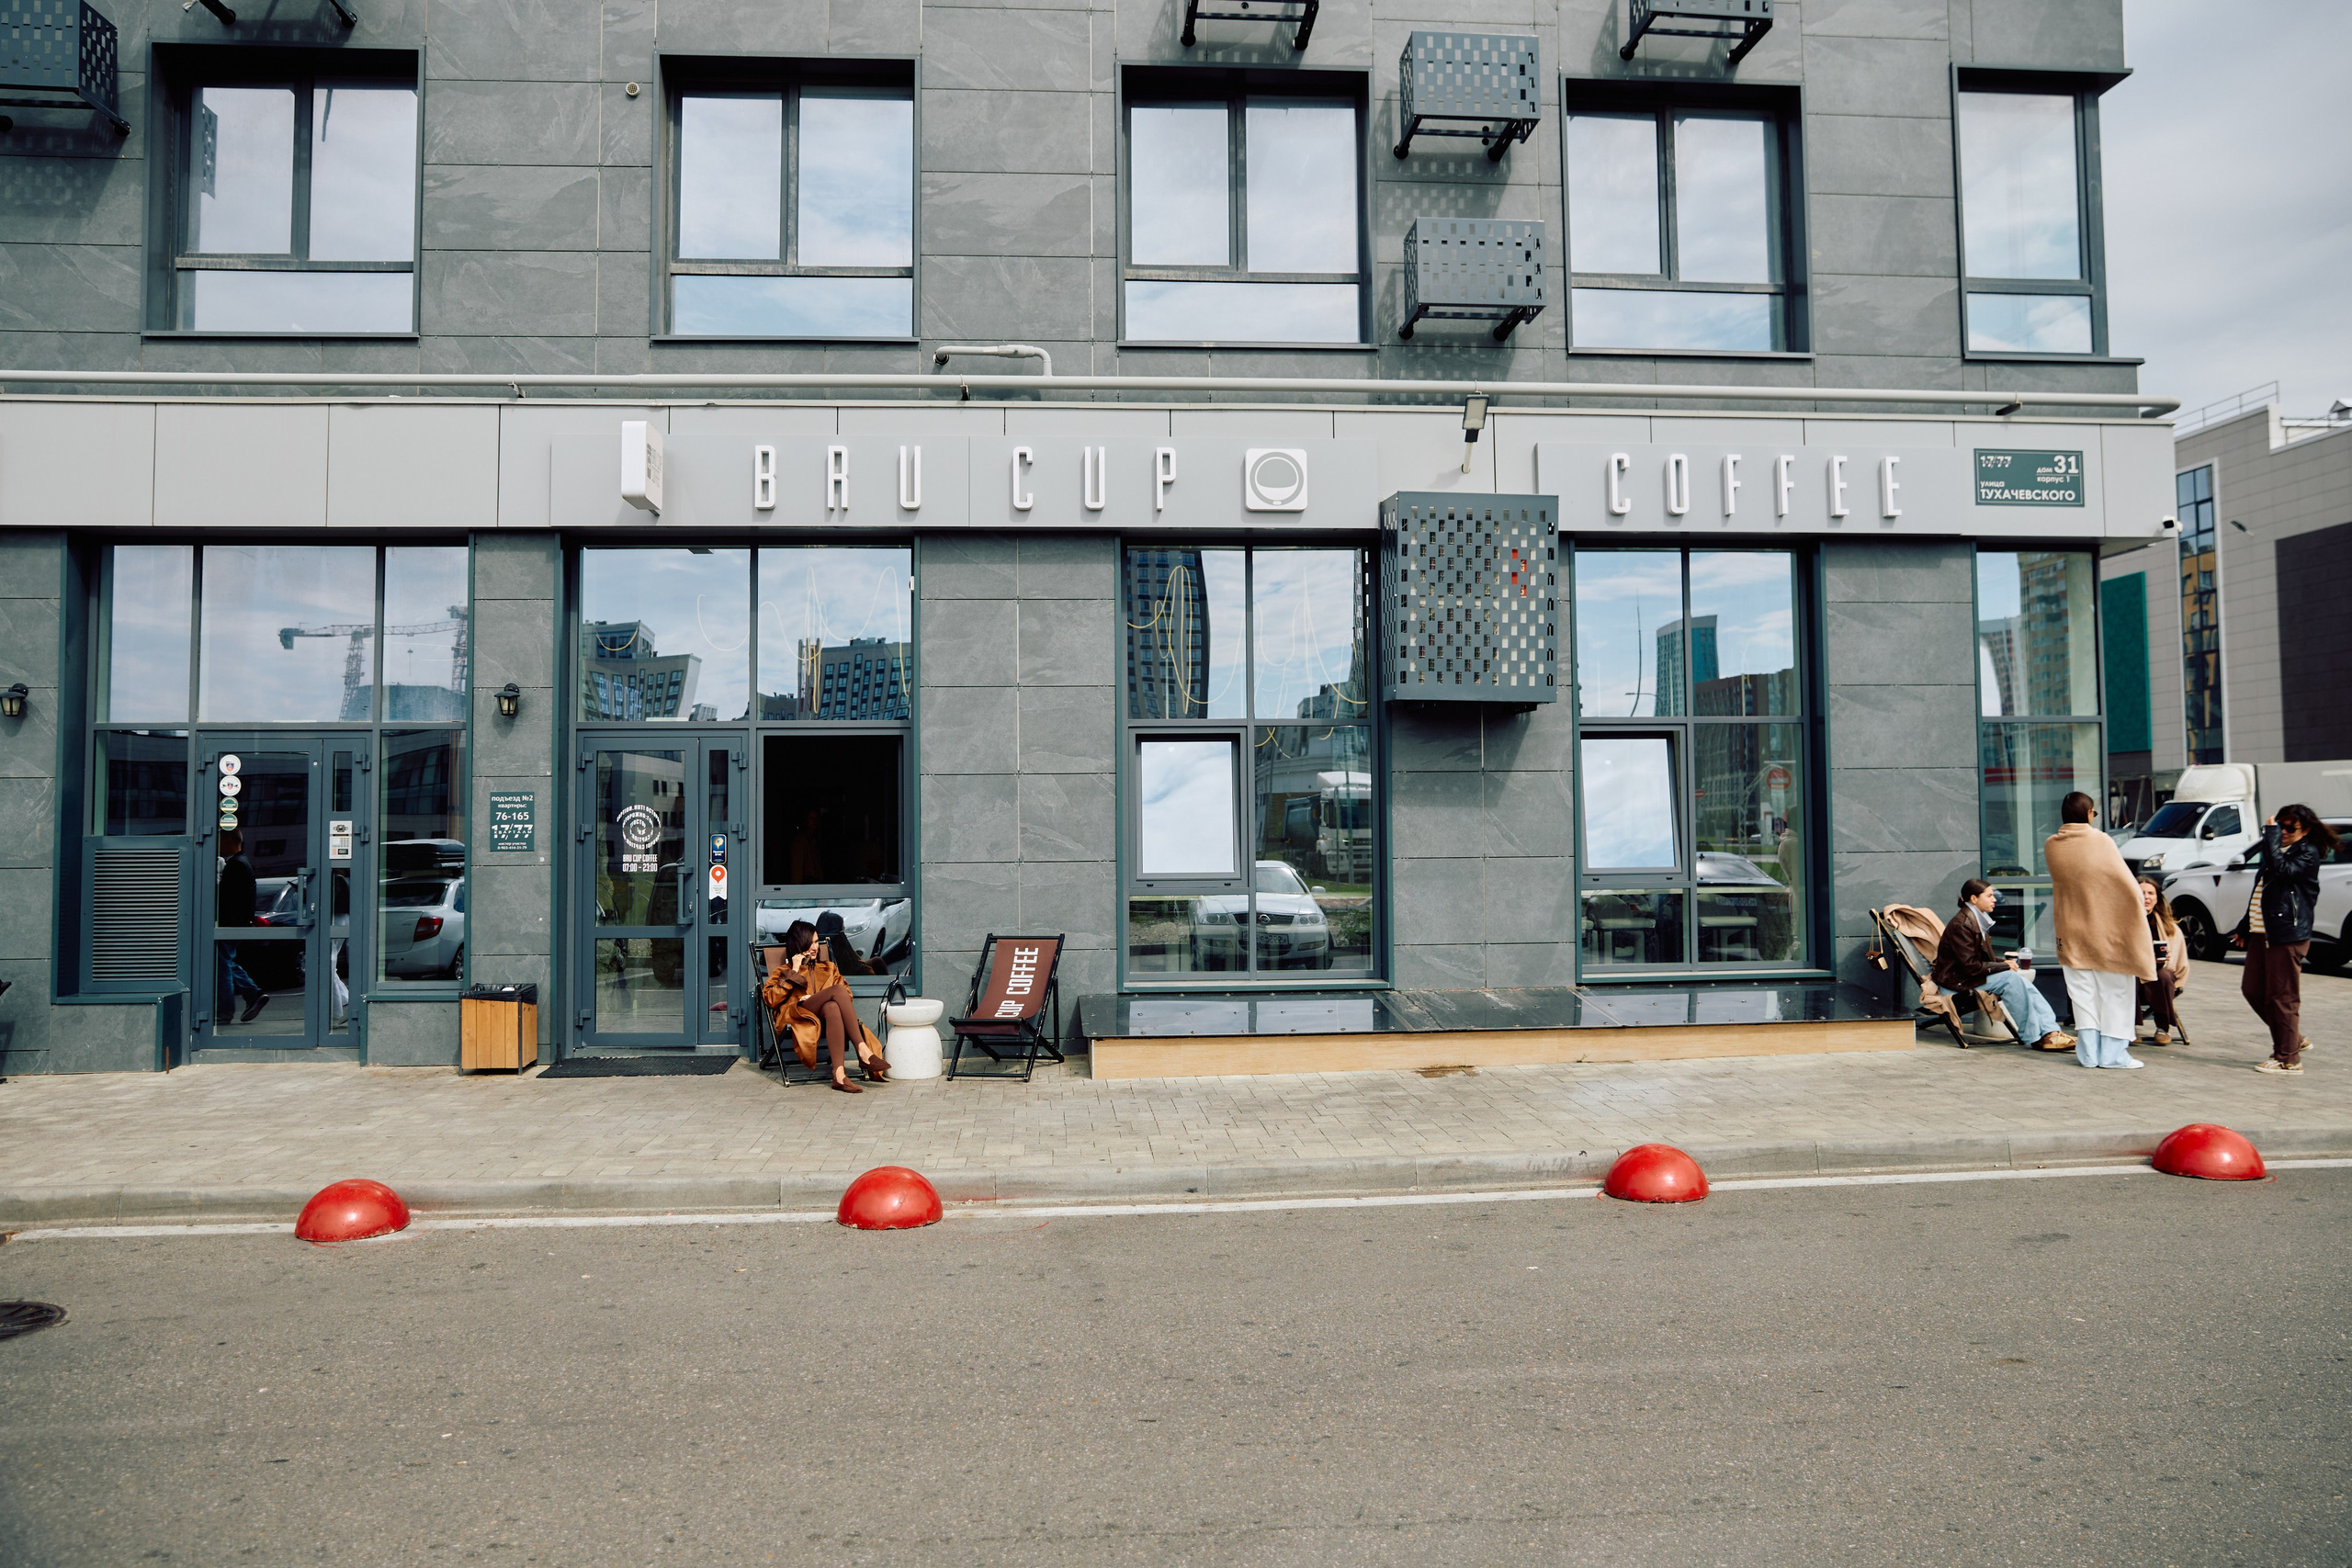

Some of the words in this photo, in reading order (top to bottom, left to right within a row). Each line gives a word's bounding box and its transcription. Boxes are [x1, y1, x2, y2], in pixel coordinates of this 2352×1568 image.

[2053, 455, 2079, 474] 31
[754, 445, 922, 511] BRU
[1012, 446, 1176, 512] CUP
[1610, 453, 1902, 518] COFFEE
[2037, 476, 2064, 484] корпус
[1980, 489, 2075, 501] ТУХАЧЕВСКОГО
[495, 812, 529, 820] 76-165
[632, 854, 641, 863] CUP
[642, 854, 658, 863] COFFEE
[622, 863, 637, 872] 07:00
[643, 863, 658, 872] 23:00
[1006, 947, 1039, 995] COFFEE
[994, 1000, 1024, 1018] CUP
